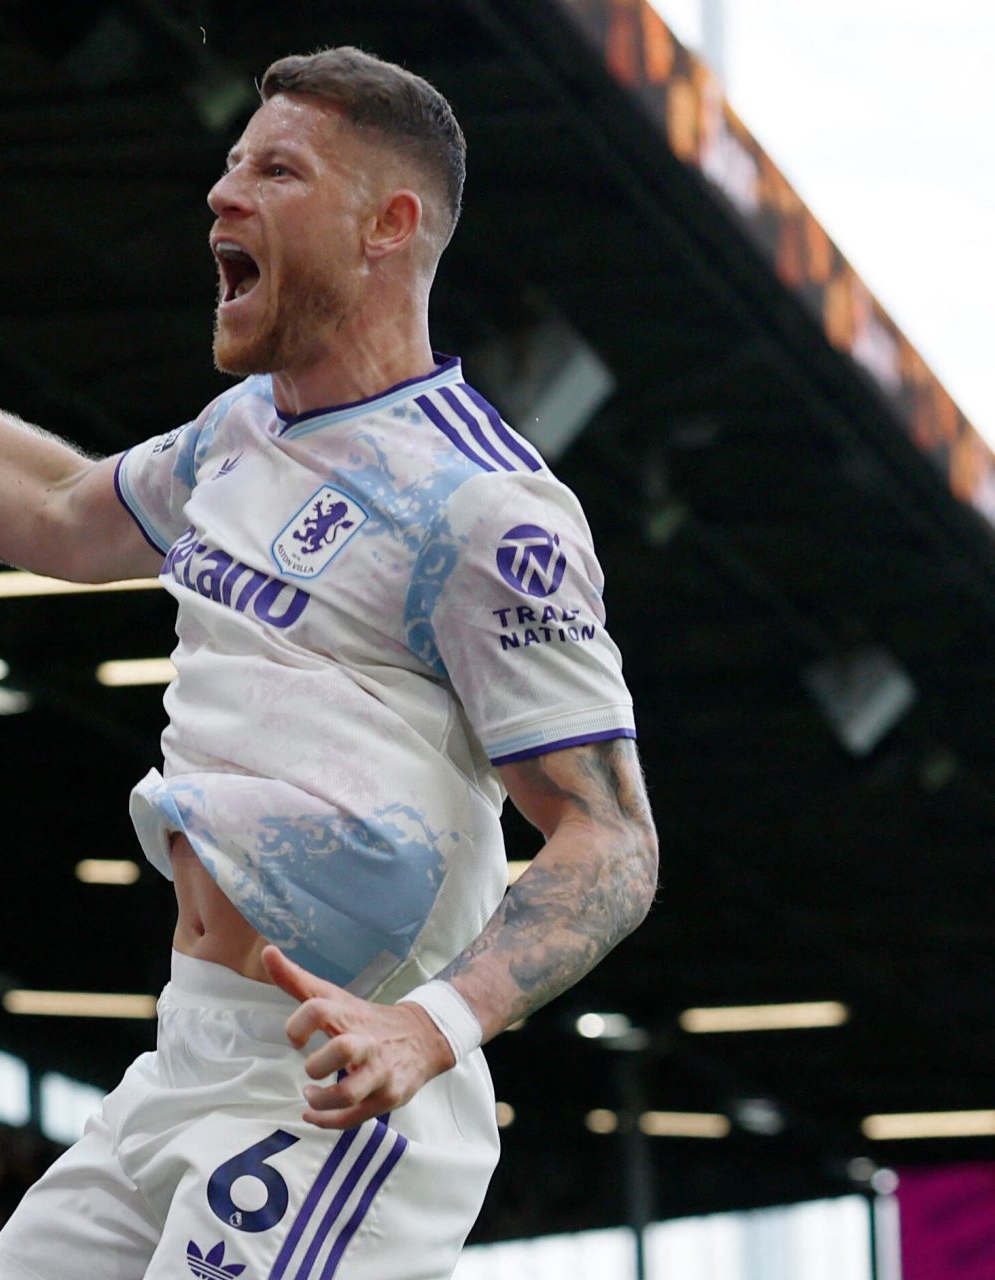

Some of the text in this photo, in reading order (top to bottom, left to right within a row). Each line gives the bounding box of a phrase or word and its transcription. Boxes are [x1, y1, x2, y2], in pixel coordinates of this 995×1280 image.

[292, 562, 314, 573] VILLA
[499, 624, 595, 651] NATION
[207, 1128, 301, 1233] 6
